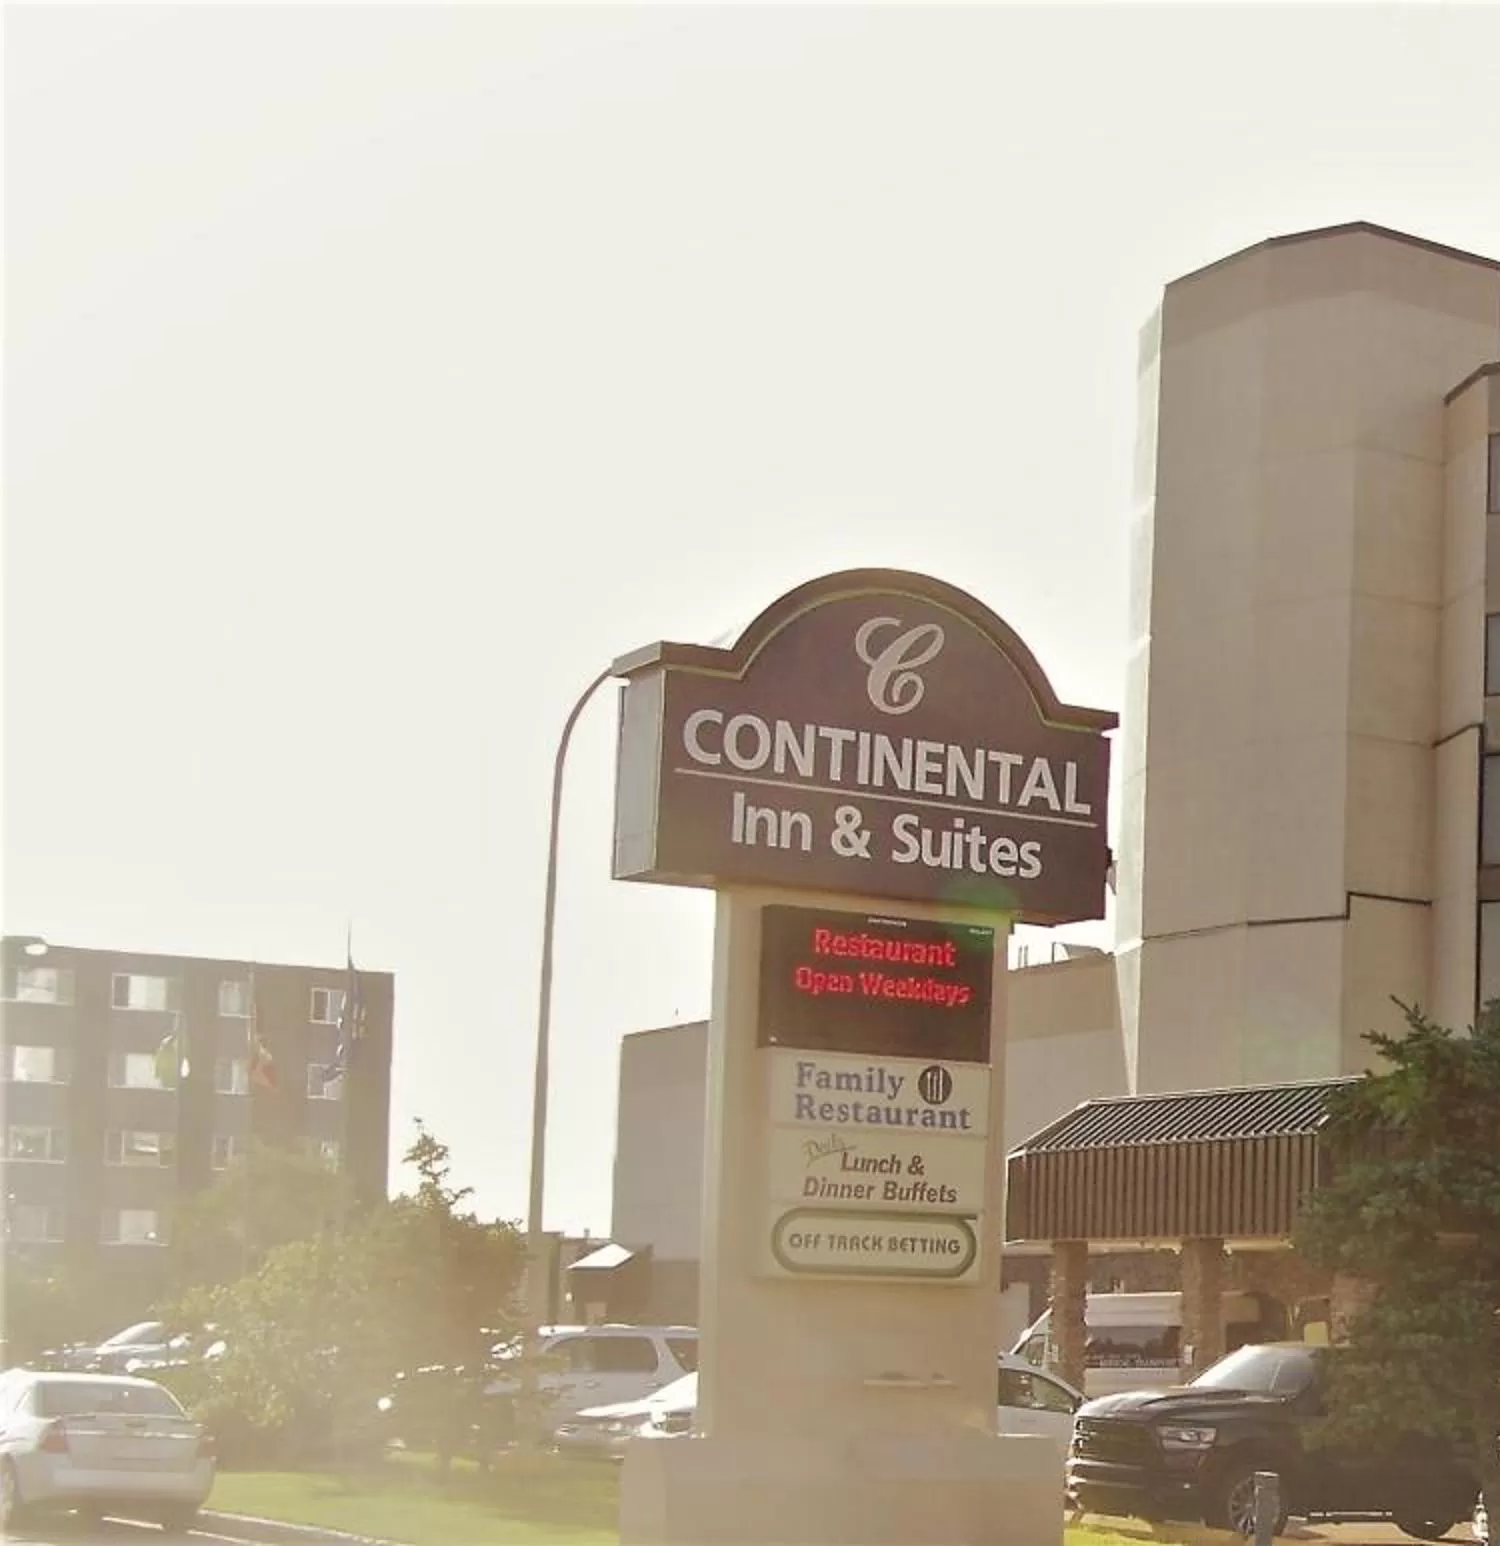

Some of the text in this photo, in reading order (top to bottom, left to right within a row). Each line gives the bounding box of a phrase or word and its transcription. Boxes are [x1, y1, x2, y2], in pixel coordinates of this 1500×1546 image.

[683, 709, 1092, 816] CONTINENTAL
[731, 791, 1042, 879] Inn & Suites
[814, 928, 957, 967] Restaurant
[794, 966, 971, 1006] Open Weekdays
[795, 1061, 904, 1100] Family
[794, 1093, 972, 1129] Restaurant
[840, 1151, 925, 1176] Lunch &
[803, 1175, 958, 1204] Dinner Buffets
[789, 1233, 961, 1254] OFF TRACK BETTING
